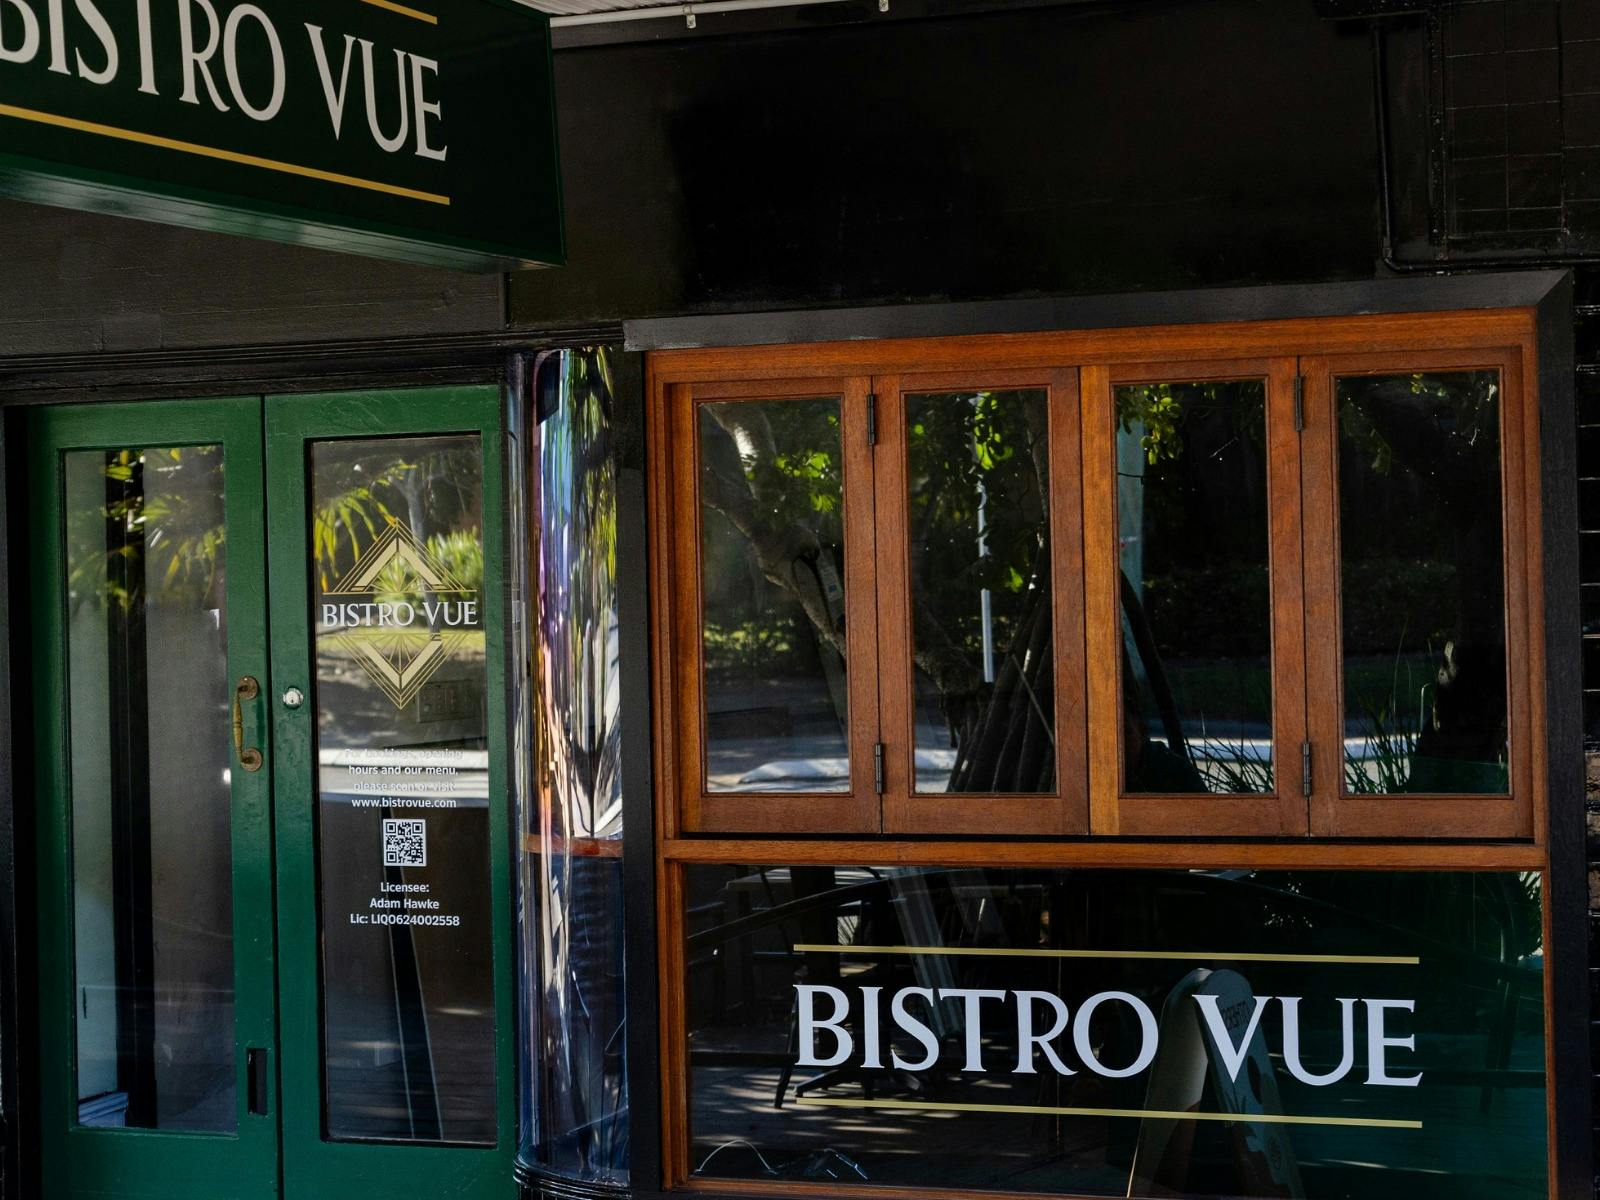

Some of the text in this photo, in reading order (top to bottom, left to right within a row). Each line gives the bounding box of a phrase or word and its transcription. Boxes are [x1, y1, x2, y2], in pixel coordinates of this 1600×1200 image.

[303, 22, 448, 162] VUE
[322, 601, 478, 627] BISTRO VUE
[348, 765, 378, 775] hours
[381, 765, 401, 775] and
[404, 767, 423, 775] our
[353, 781, 456, 793] please scan or visit
[351, 797, 457, 808] www.bistrovue.com
[380, 882, 430, 893] Licensee:
[369, 897, 440, 909] Adam Hawke
[350, 913, 368, 924] Lic:
[793, 984, 1423, 1087] BISTRO VUE
